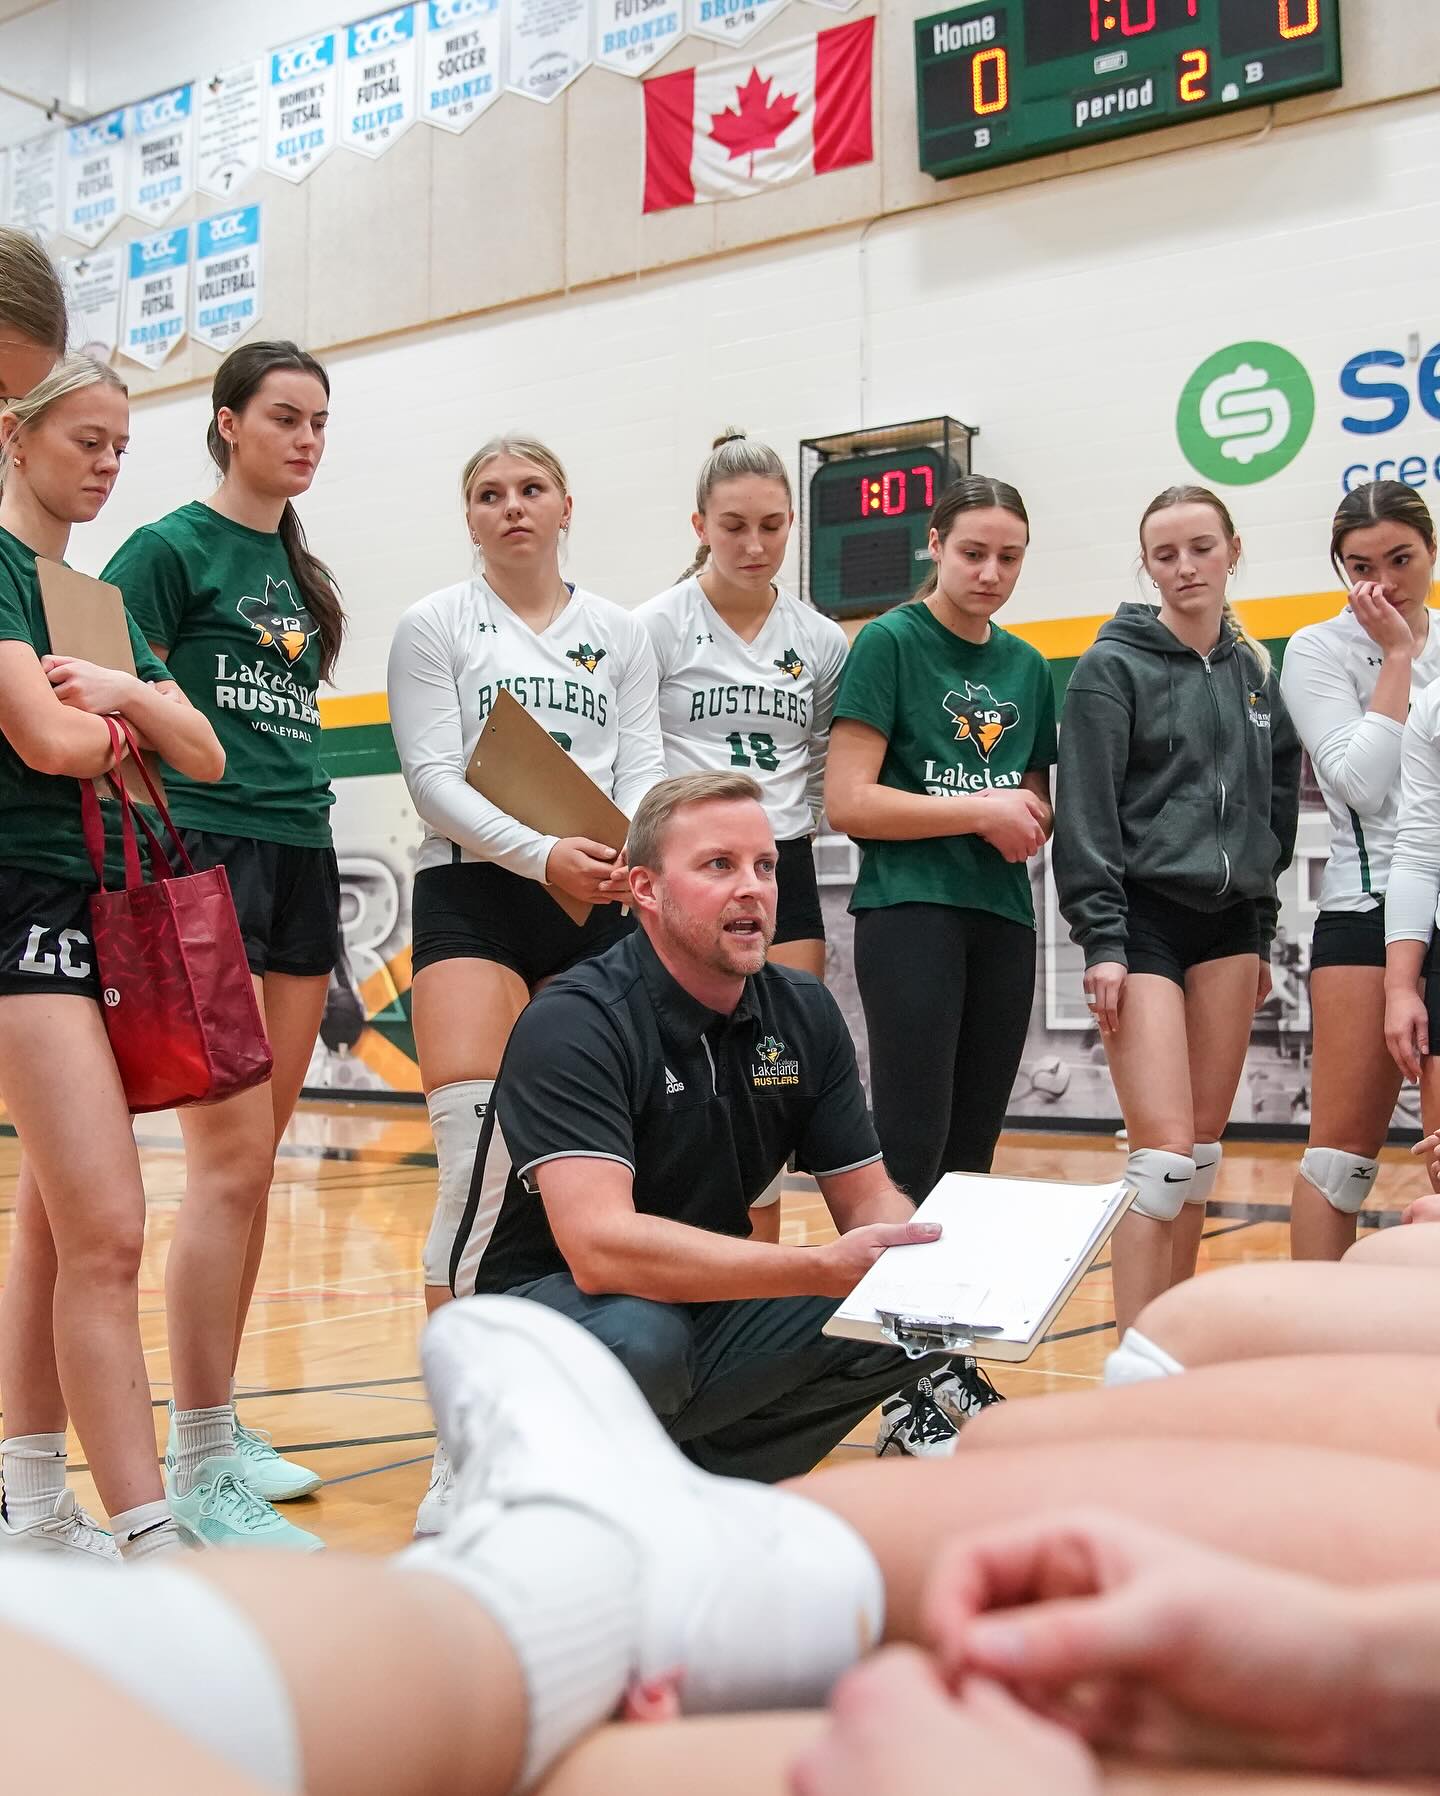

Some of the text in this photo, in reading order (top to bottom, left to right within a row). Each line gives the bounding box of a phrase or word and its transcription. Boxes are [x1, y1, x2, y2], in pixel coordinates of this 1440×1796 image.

[445, 30, 479, 54] MEN'S
[603, 12, 677, 54] BRONZE
[933, 15, 996, 55] Home
[364, 58, 396, 80] MEN'S
[437, 47, 486, 80] SOCCER
[529, 66, 568, 87] COACH
[1180, 49, 1208, 102] 2
[1245, 61, 1264, 84] B
[279, 82, 325, 108] WOMEN'S
[357, 76, 400, 106] FUTSAL
[430, 73, 492, 110] BRONZE
[972, 47, 1008, 115] 0
[280, 102, 321, 131] FUTSAL
[1075, 78, 1153, 128] period
[352, 103, 404, 134] SILVER
[276, 128, 324, 159] SILVER
[974, 128, 991, 148] B
[143, 151, 180, 176] FUTSAL
[78, 175, 113, 198] FUTSAL
[224, 172, 233, 190] 7
[205, 255, 249, 278] WOMEN'S
[144, 276, 172, 295] MEN'S
[198, 271, 256, 301] VOLLEYBALL
[141, 292, 174, 318] FUTSAL
[130, 316, 182, 346] BRONZE
[861, 465, 933, 517] 1:07
[690, 685, 806, 728] RUSTLERS
[251, 721, 313, 743] VOLLEYBALL
[725, 732, 780, 771] 18
[923, 760, 1022, 790] Lakelan
[19, 924, 90, 978] LC
[751, 1061, 799, 1077] Lakeland
[753, 1076, 800, 1087] RUSTLERS
